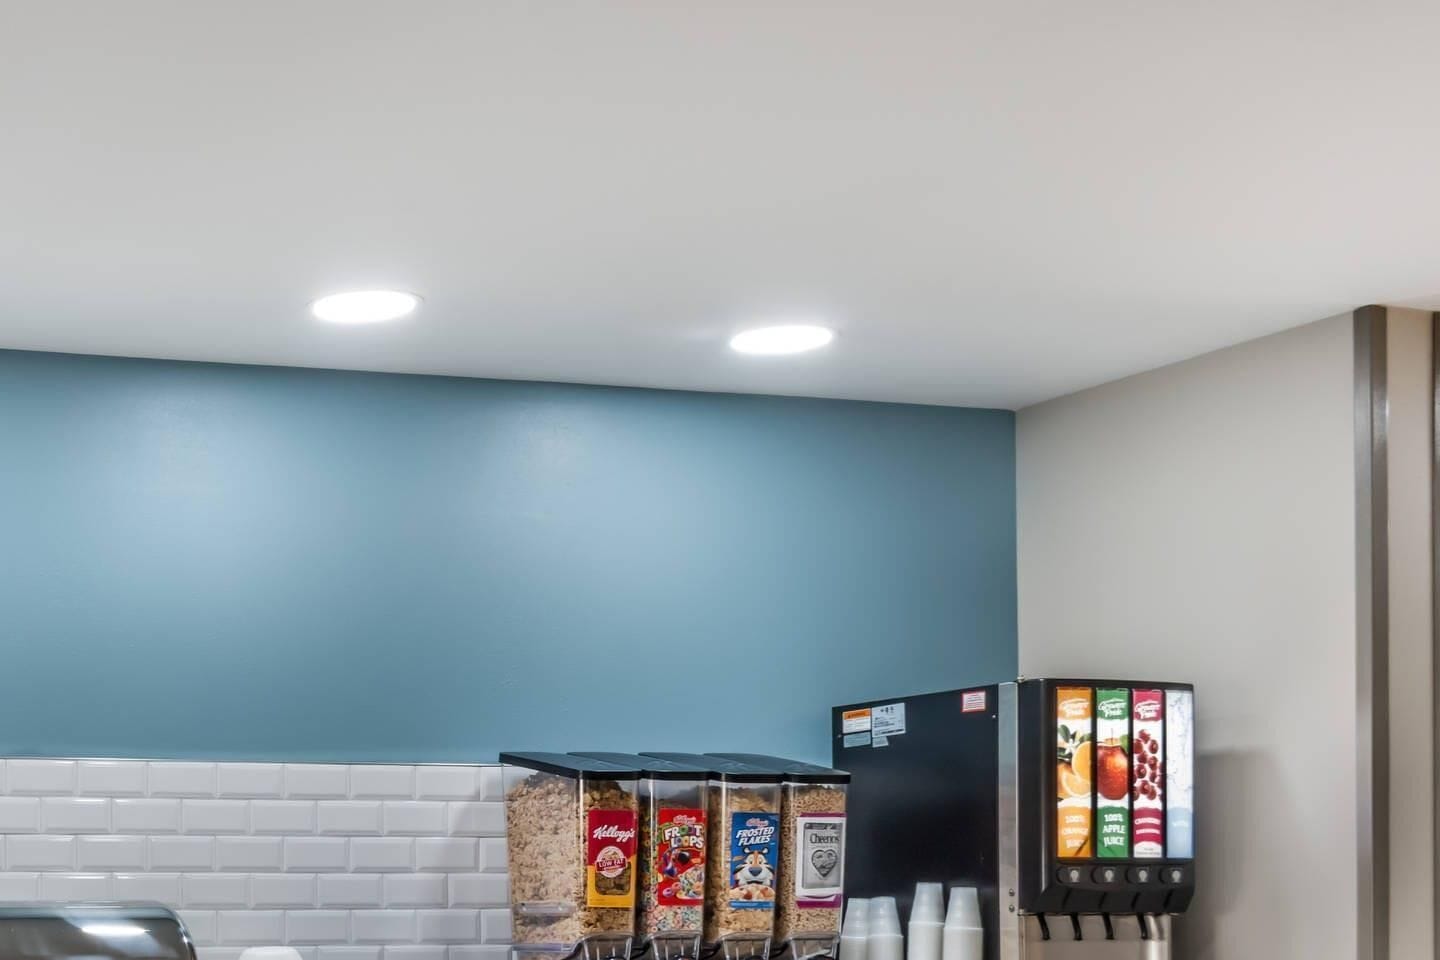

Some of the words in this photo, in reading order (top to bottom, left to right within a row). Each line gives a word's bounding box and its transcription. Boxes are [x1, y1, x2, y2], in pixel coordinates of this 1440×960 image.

[1104, 813, 1124, 822] 100%
[592, 824, 635, 842] Kellogg's
[736, 826, 775, 839] FROSTED
[1102, 824, 1126, 834] APPLE
[671, 835, 705, 849] LOOPS
[738, 835, 771, 847] FLAKES
[1103, 836, 1126, 847] JUICE
[598, 859, 613, 868] LOW
[614, 858, 625, 866] FAT
